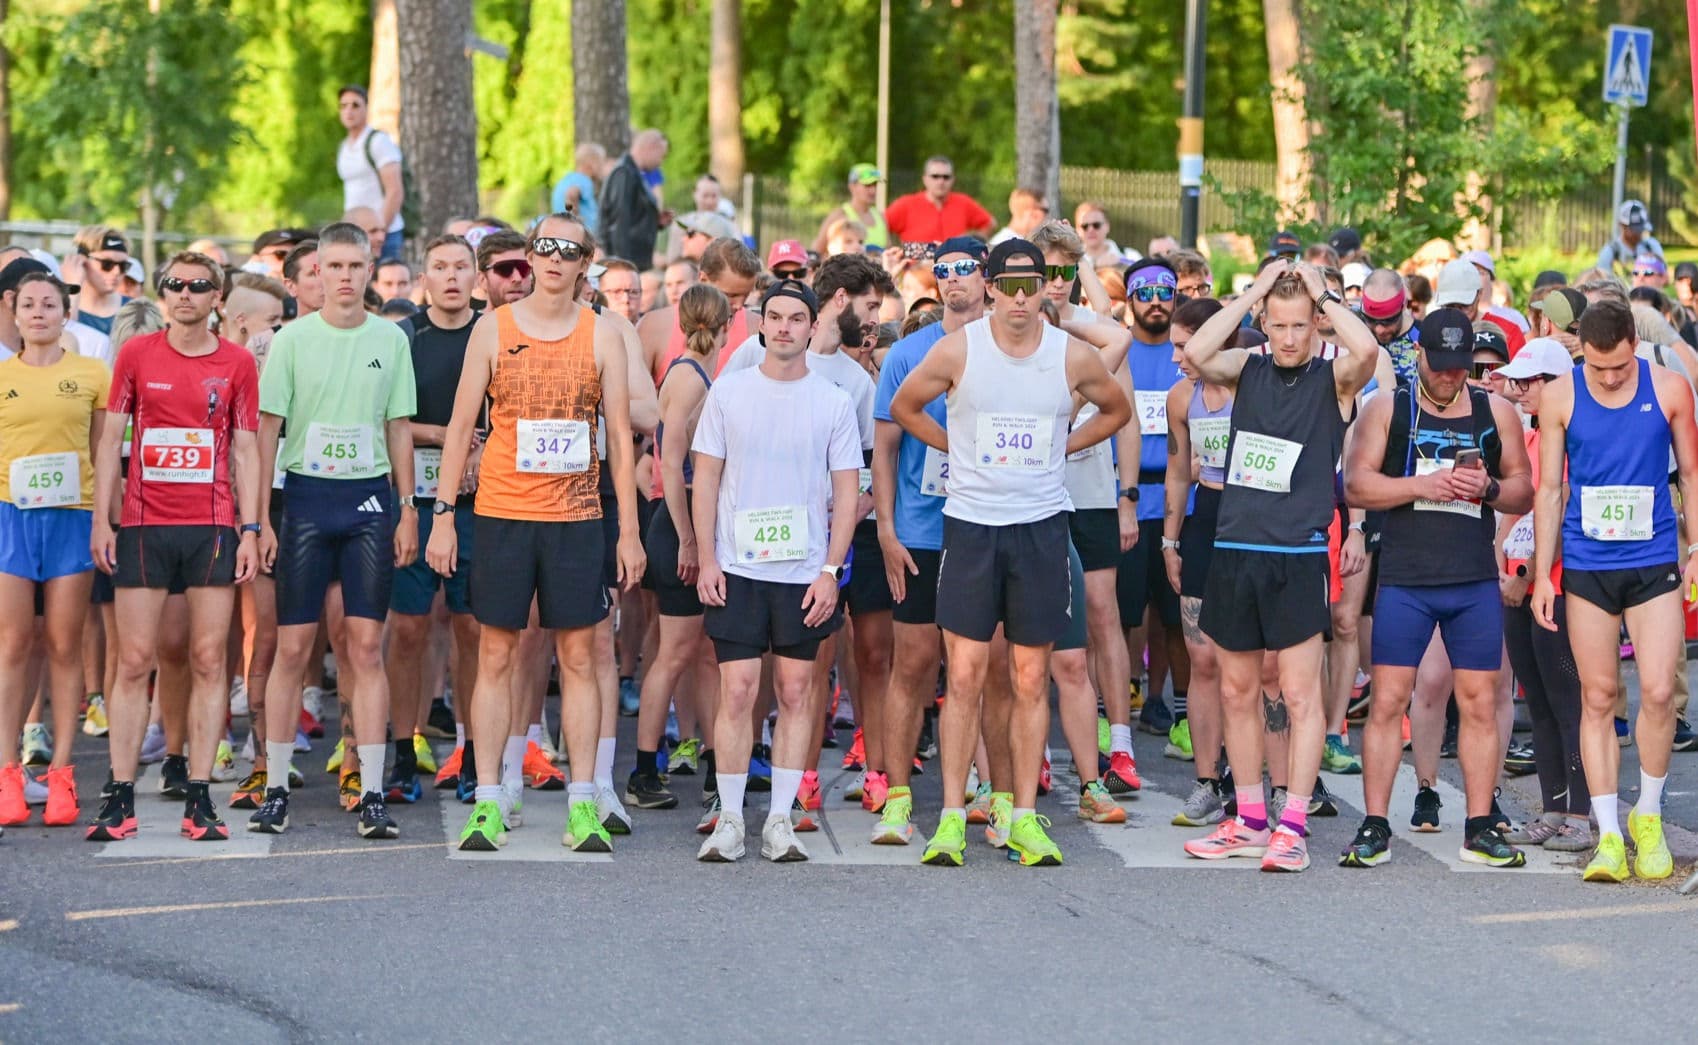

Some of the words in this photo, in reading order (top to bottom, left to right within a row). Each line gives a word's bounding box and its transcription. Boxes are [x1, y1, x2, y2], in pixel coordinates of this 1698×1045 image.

[536, 438, 571, 454] 347
[996, 432, 1032, 450] 340
[1204, 434, 1229, 450] 468
[155, 448, 200, 467] 739
[322, 443, 357, 458] 453
[1024, 458, 1043, 466] 10km
[1244, 452, 1276, 471] 505
[28, 471, 63, 488] 459
[148, 470, 208, 479] www.runhigh.fi
[1266, 480, 1282, 489] 5km
[1601, 504, 1634, 520] 451
[754, 524, 791, 543] 428
[1514, 527, 1532, 542] 226
[787, 548, 803, 556] 5km
